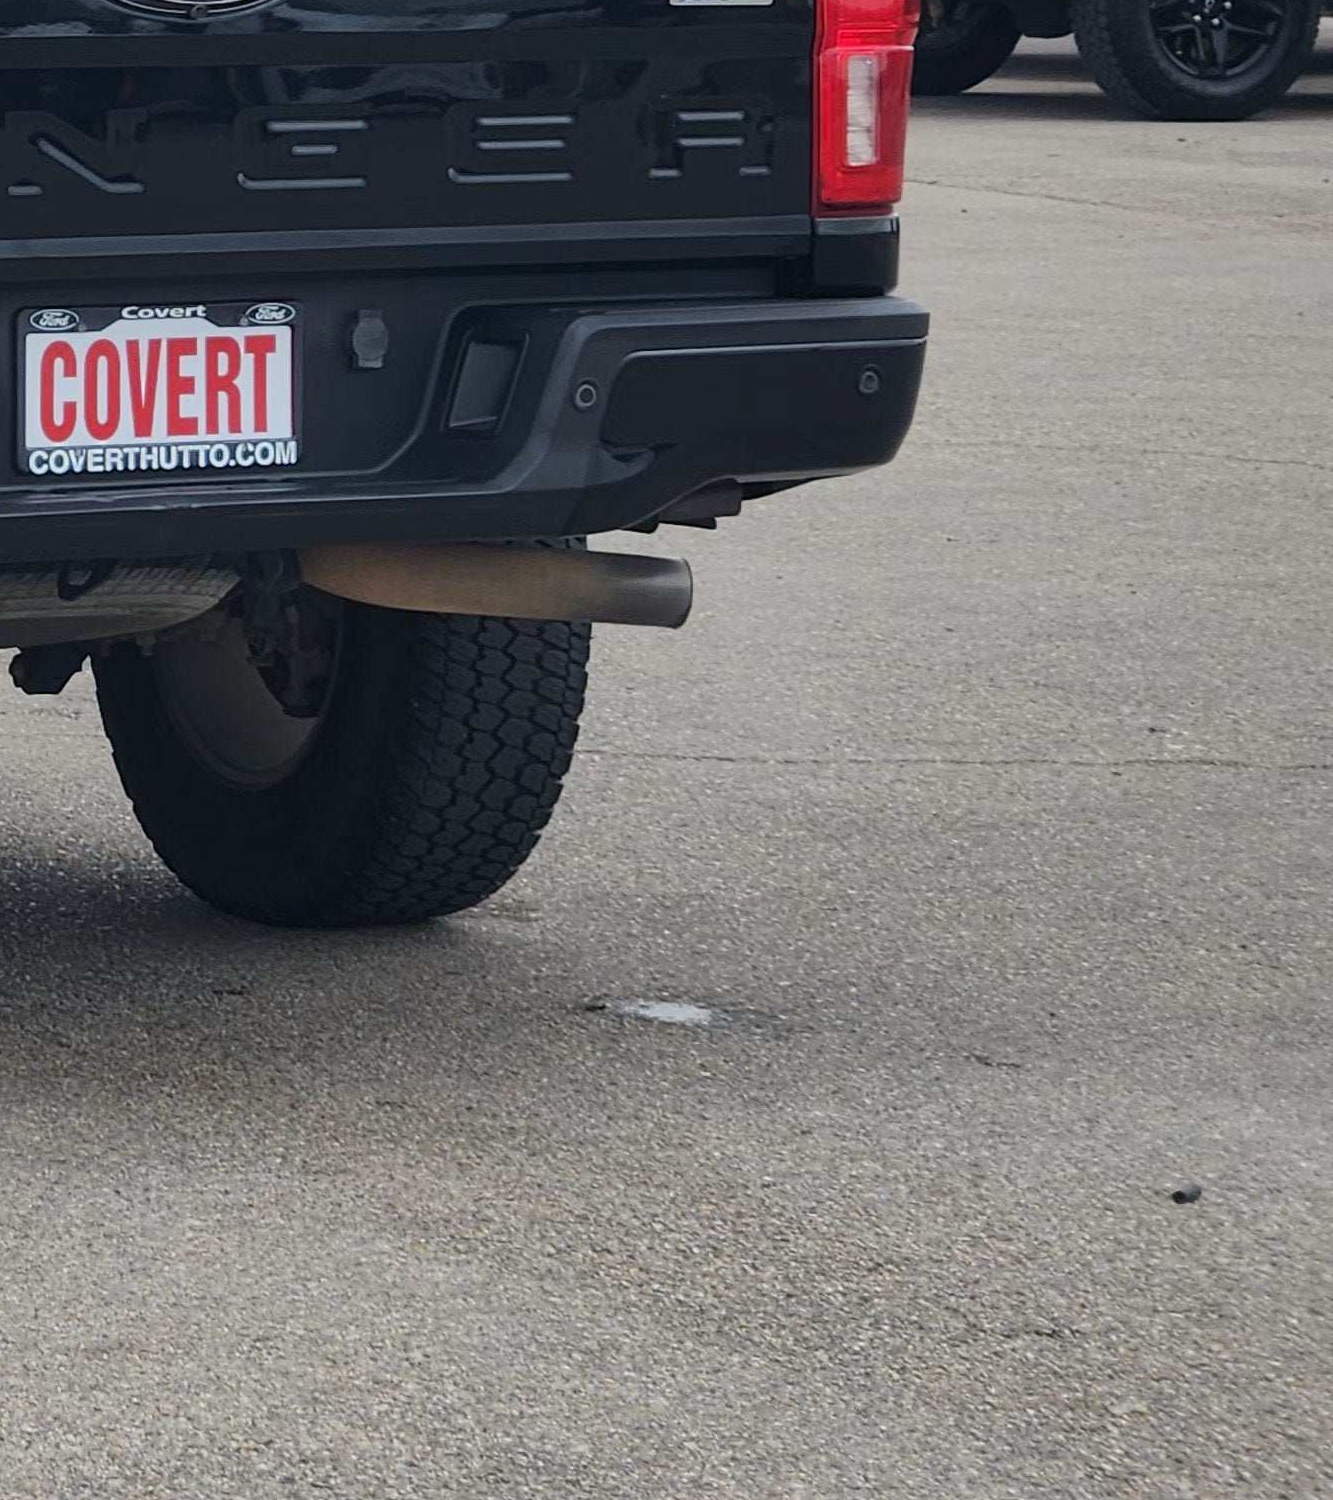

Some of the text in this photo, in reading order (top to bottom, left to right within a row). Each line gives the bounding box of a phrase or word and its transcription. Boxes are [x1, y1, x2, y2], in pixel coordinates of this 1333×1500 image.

[121, 304, 207, 320] Covert
[39, 334, 277, 443] COVERT
[28, 440, 298, 476] COVERTHUTTO.COM
